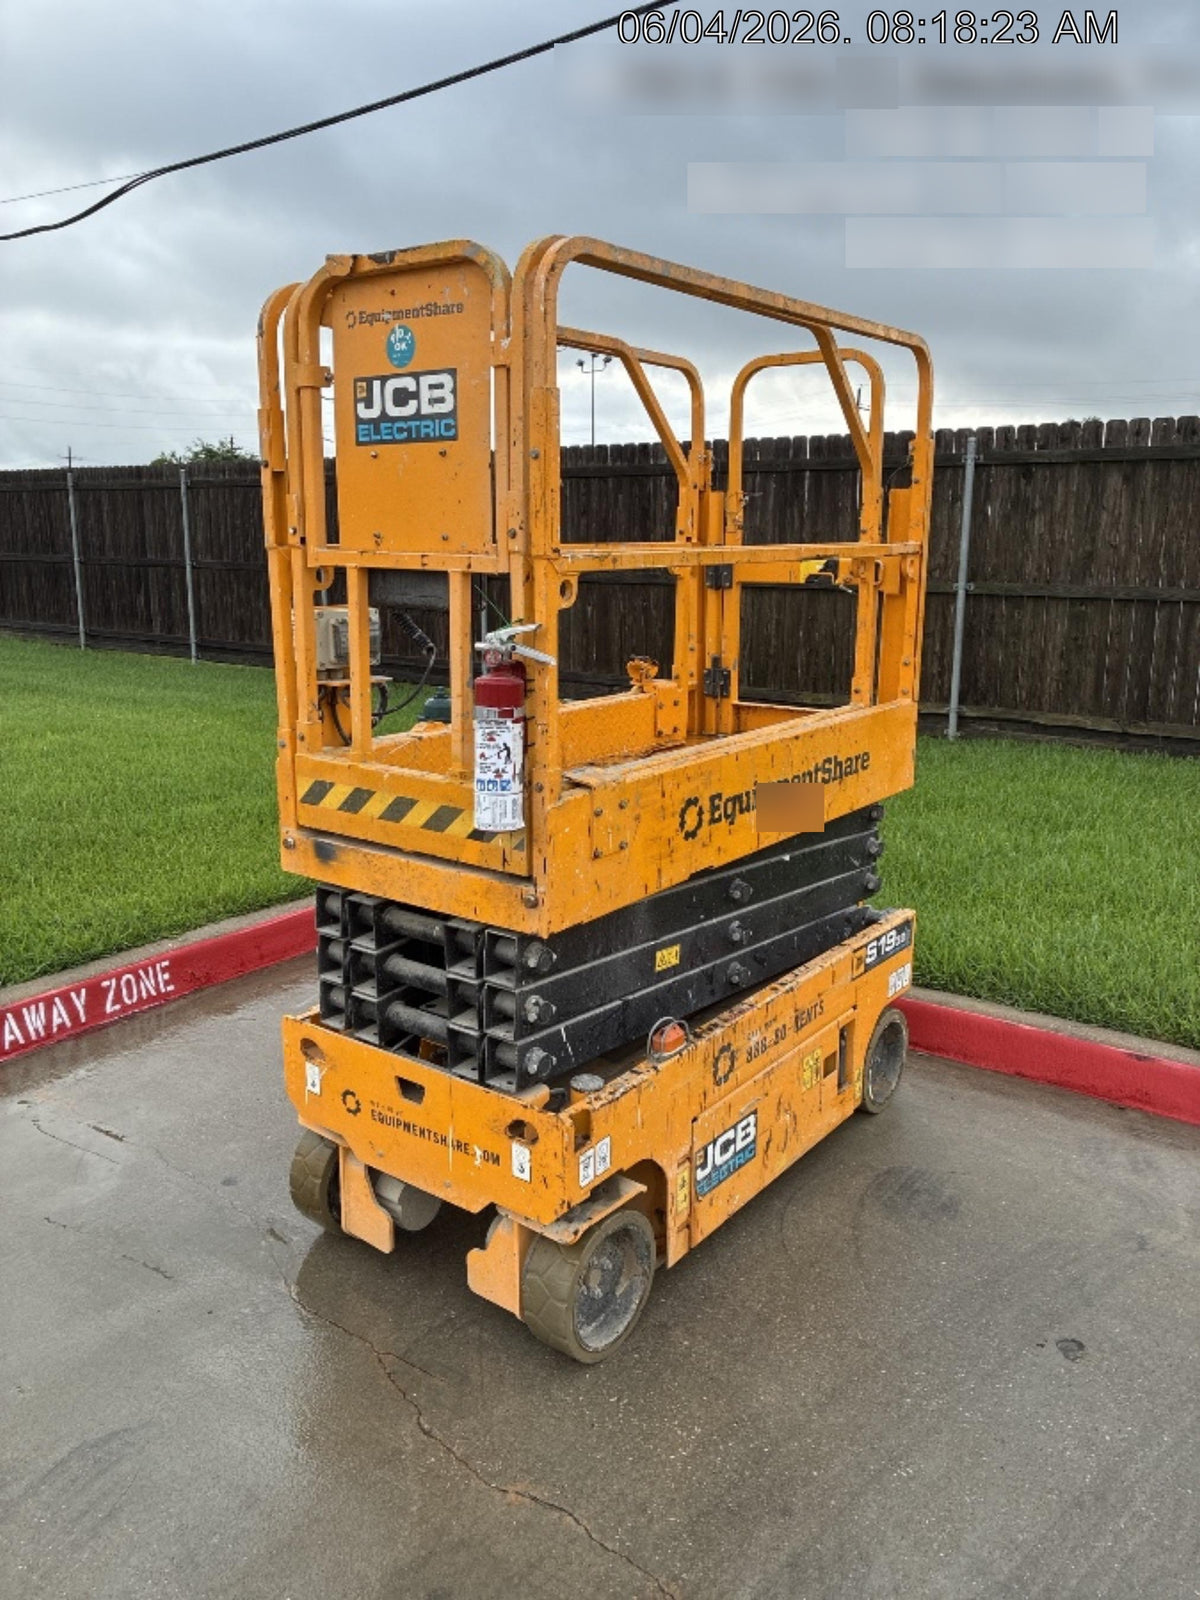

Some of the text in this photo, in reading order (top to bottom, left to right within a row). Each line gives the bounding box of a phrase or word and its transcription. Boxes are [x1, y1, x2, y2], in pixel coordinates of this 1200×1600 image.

[358, 301, 464, 326] EquipmentShare
[356, 372, 454, 419] JCB
[357, 418, 456, 442] ELECTRIC
[708, 751, 870, 826] EquintShare
[3, 960, 175, 1050] AWAY ZONE
[370, 1108, 501, 1167] EQUIPMENTSHRE.OM
[696, 1114, 756, 1181] JCB
